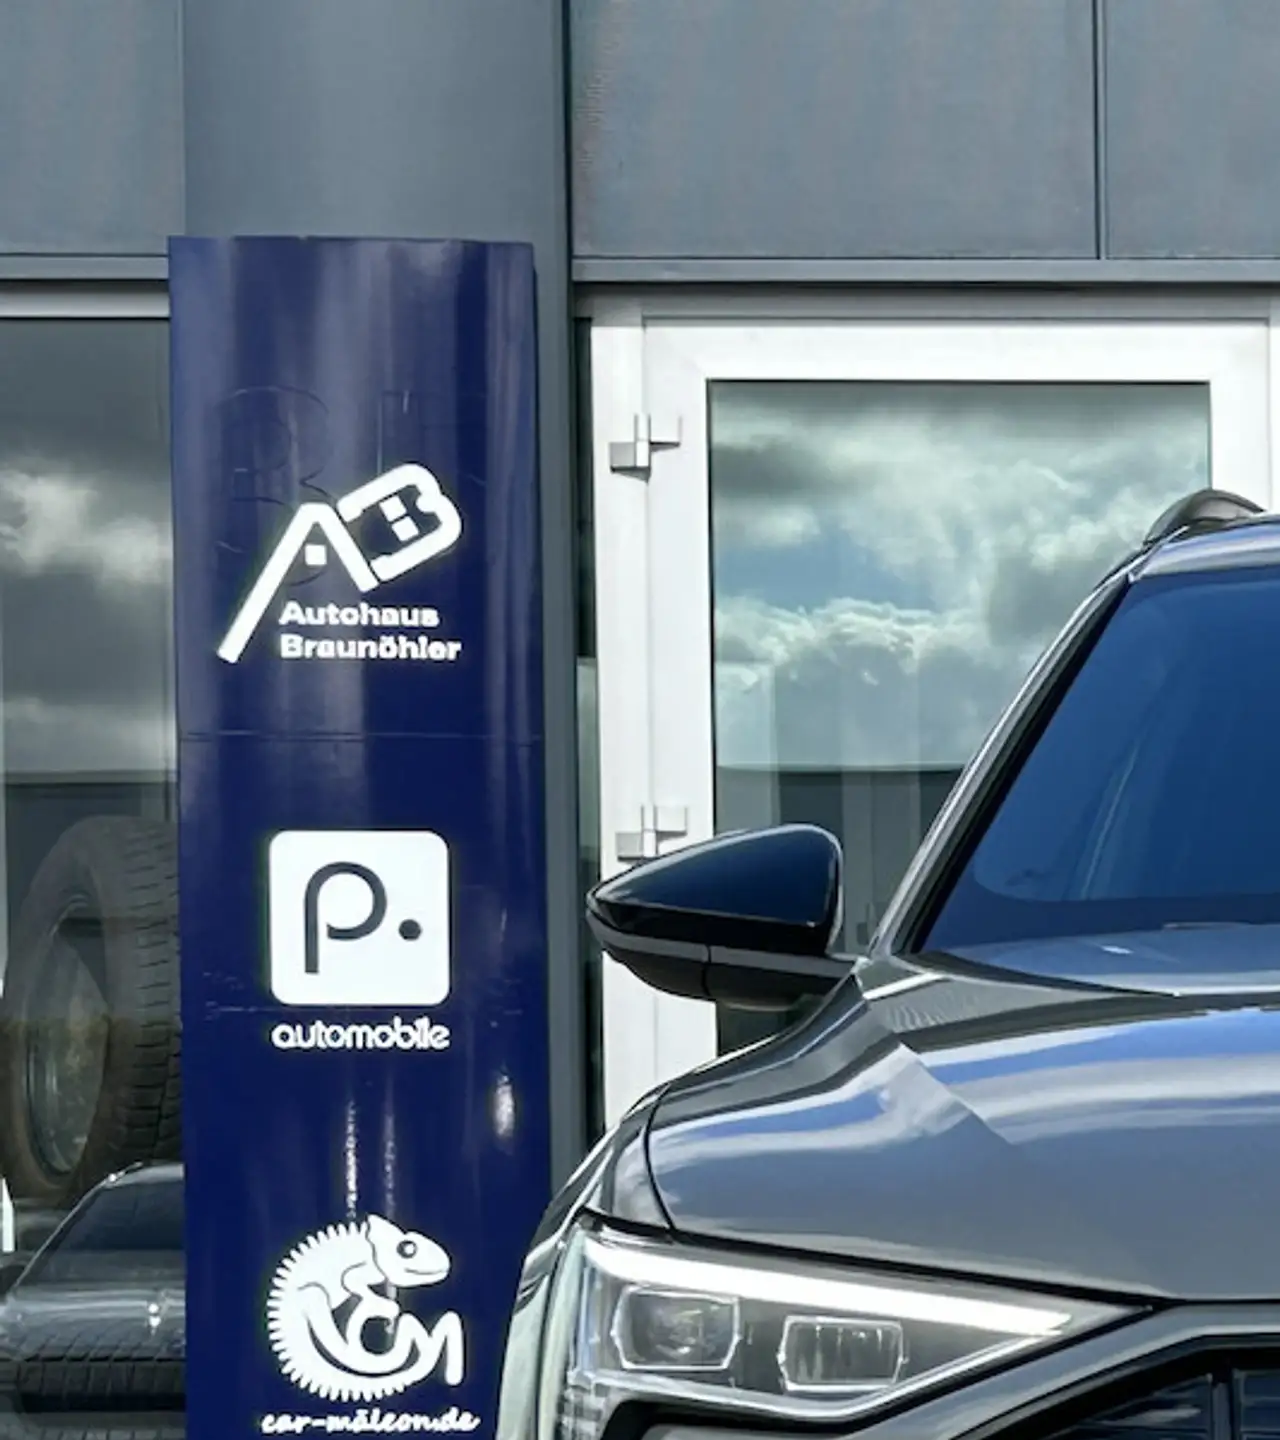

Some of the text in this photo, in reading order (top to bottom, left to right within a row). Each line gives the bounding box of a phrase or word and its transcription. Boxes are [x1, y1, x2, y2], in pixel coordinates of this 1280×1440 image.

[218, 465, 461, 663] AB
[279, 601, 439, 626] Autohaus
[280, 634, 461, 660] Braunöhler
[272, 1016, 449, 1049] automobile
